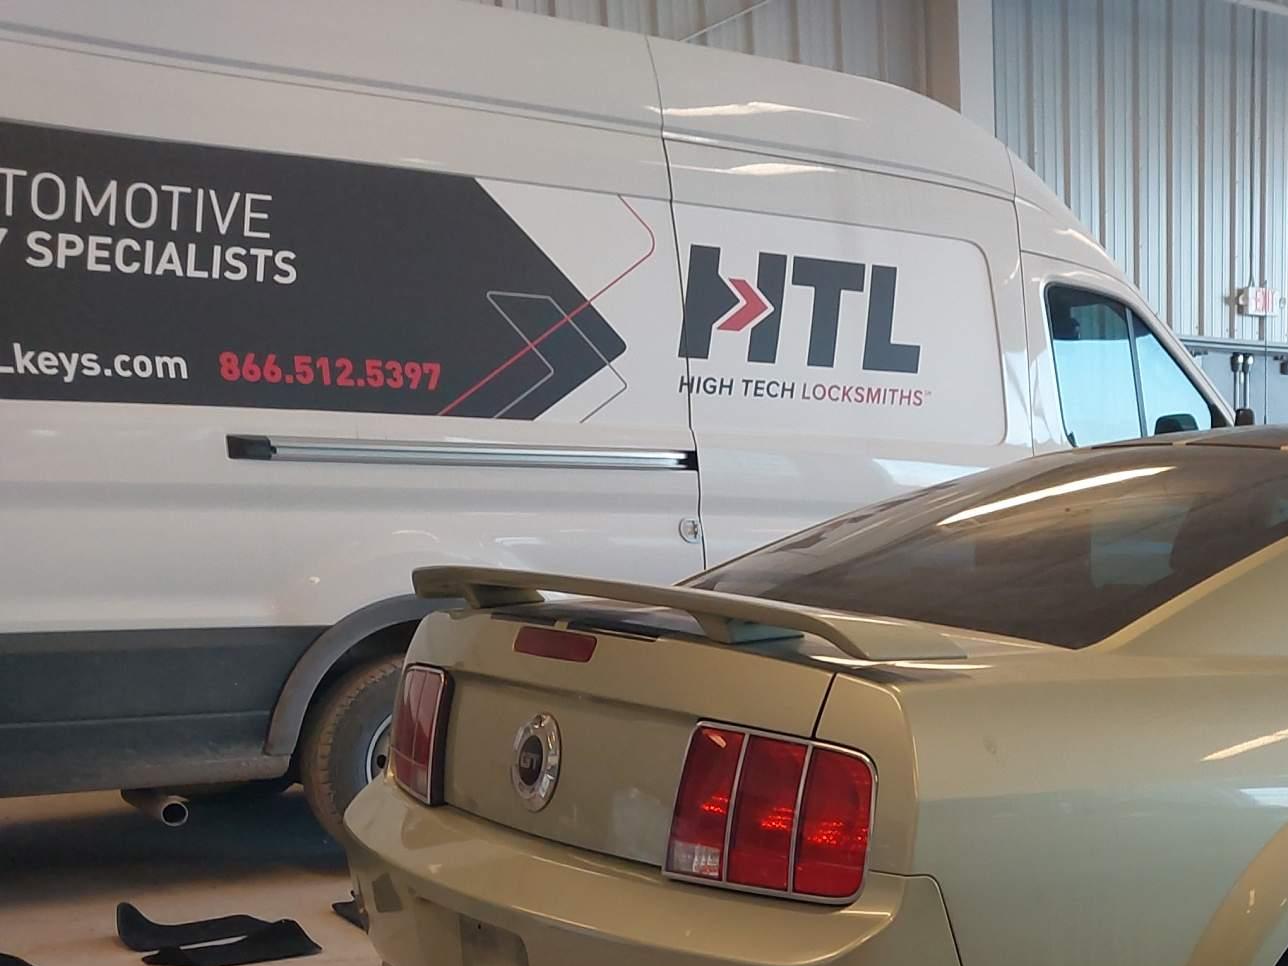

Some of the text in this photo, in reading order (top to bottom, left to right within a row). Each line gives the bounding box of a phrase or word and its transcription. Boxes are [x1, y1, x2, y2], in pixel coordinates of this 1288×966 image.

[0, 167, 272, 239] TOMOTIVE
[26, 230, 297, 284] SPECIALISTS
[678, 243, 921, 374] HTL
[218, 351, 441, 390] 866.512.5397
[678, 375, 924, 406] HIGH TECH LOCKSMITHS
